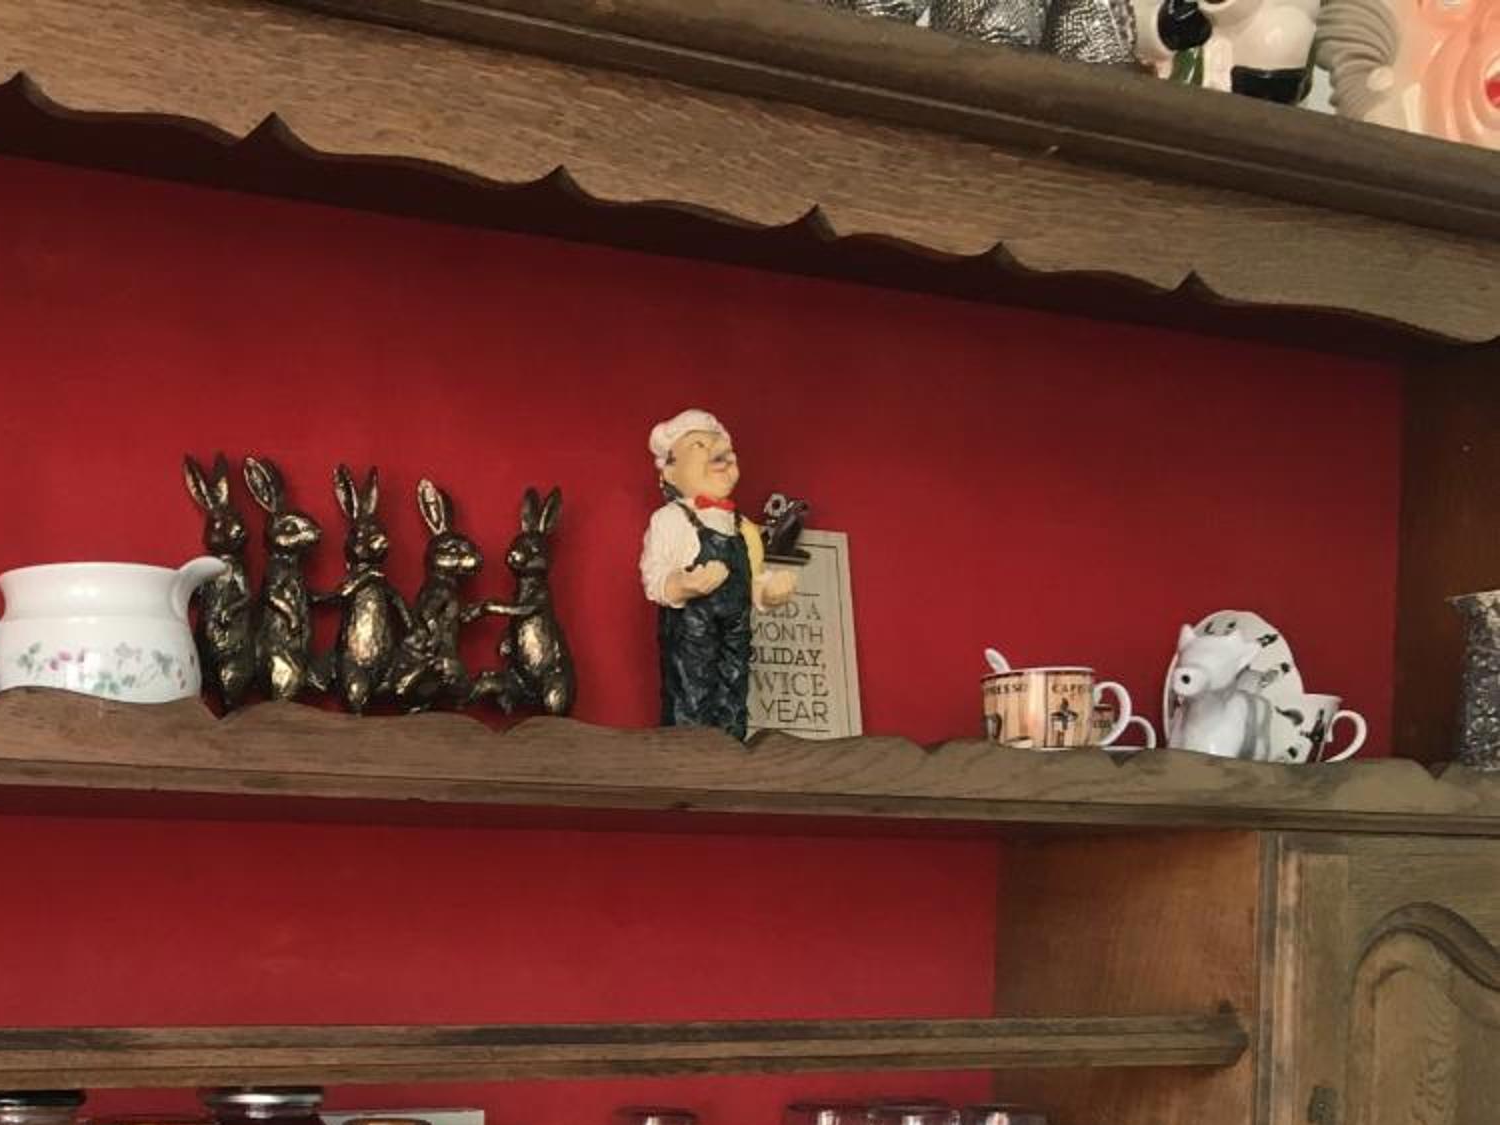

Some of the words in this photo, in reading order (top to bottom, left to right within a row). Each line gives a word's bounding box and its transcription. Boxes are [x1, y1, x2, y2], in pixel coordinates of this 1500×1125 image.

[747, 647, 827, 671] OLIDAY,
[747, 670, 829, 697] WICE
[761, 698, 829, 724] YEAR
